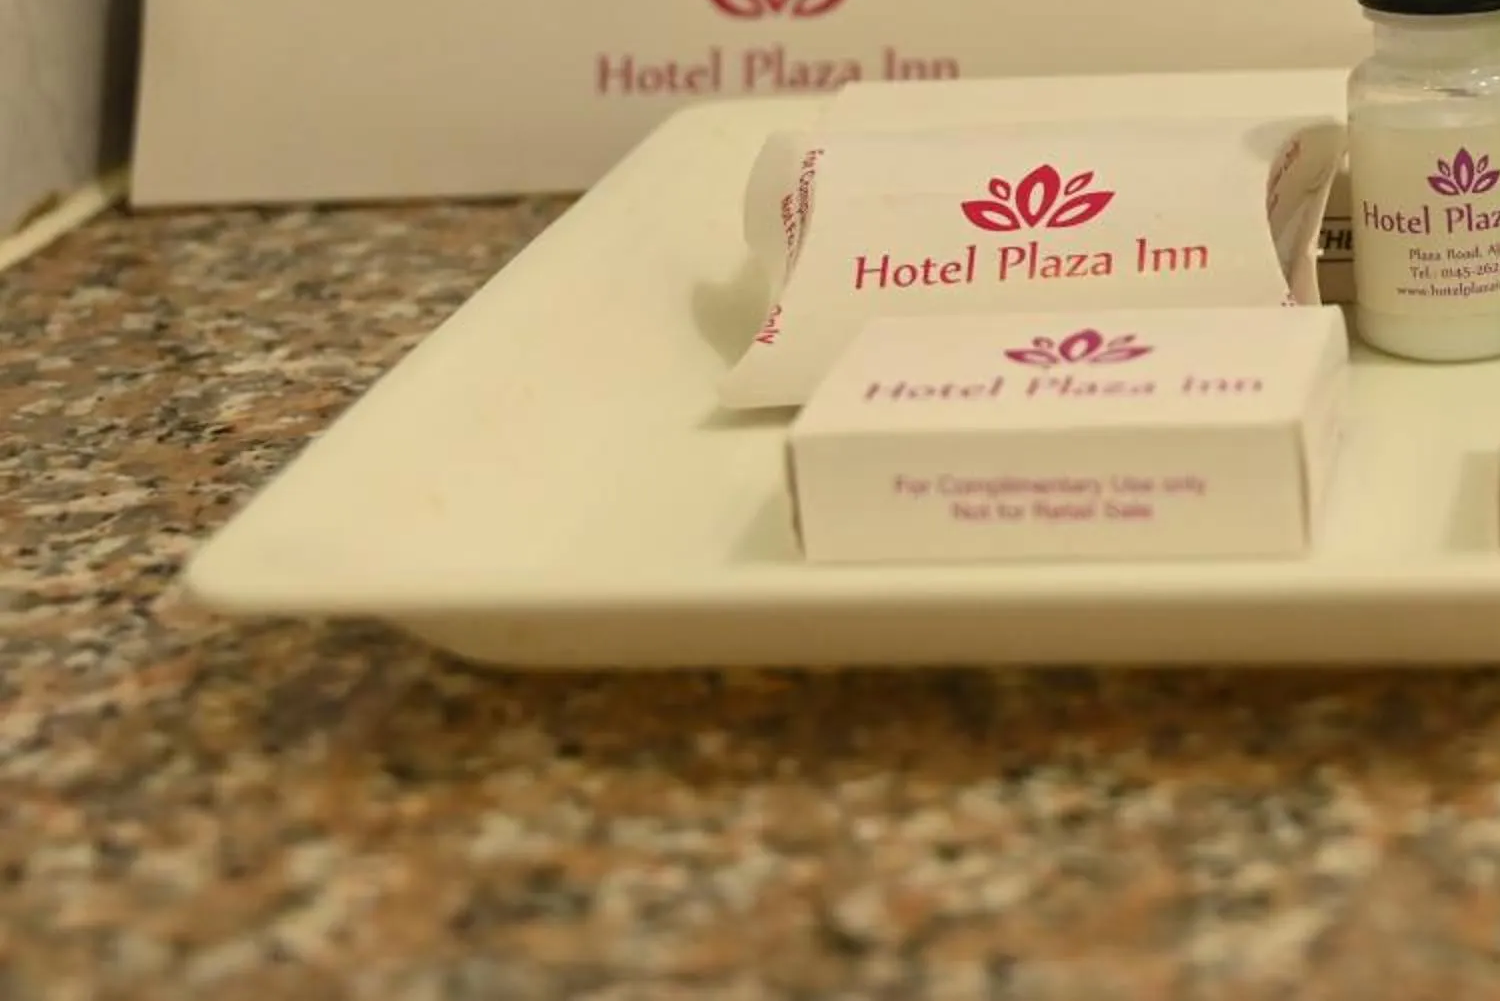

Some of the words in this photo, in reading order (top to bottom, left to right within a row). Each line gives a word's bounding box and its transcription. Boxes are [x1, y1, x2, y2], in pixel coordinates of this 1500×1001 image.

[596, 47, 722, 94] Hotel
[742, 43, 863, 93] Plaza
[883, 46, 960, 82] Inn
[1363, 200, 1431, 235] Hotel
[855, 244, 976, 290] Hotel
[998, 241, 1113, 282] Plaza
[1137, 238, 1208, 274] Inn
[864, 375, 1005, 401] Hotel
[1025, 374, 1158, 398] Plaza
[1181, 374, 1264, 396] Inn
